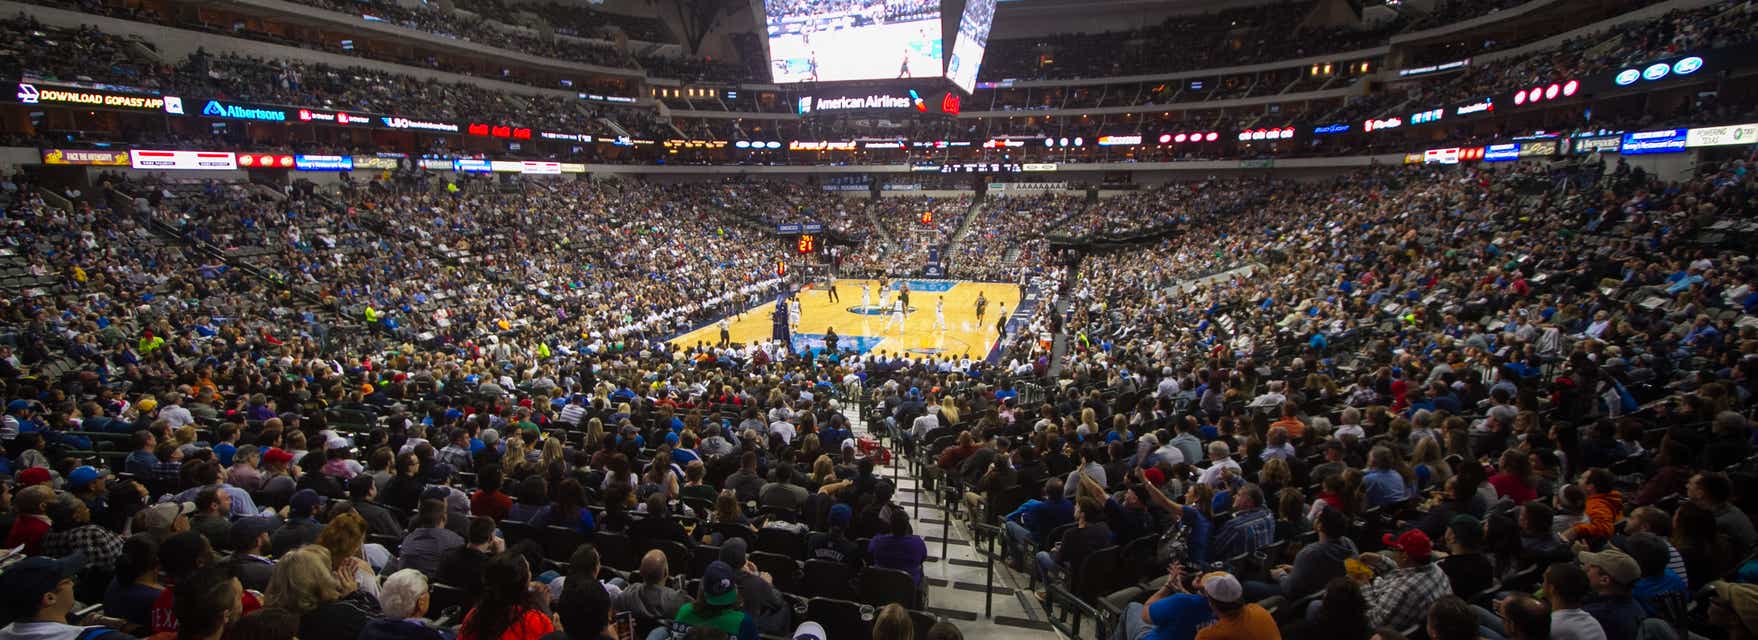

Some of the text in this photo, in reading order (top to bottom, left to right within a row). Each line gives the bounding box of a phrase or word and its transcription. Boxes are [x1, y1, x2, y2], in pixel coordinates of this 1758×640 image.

[40, 90, 102, 104] DOWNLOAD
[144, 99, 163, 108] APP
[816, 95, 911, 110] American Airlines
[227, 105, 285, 121] Albertsons
[800, 240, 812, 252] 21
